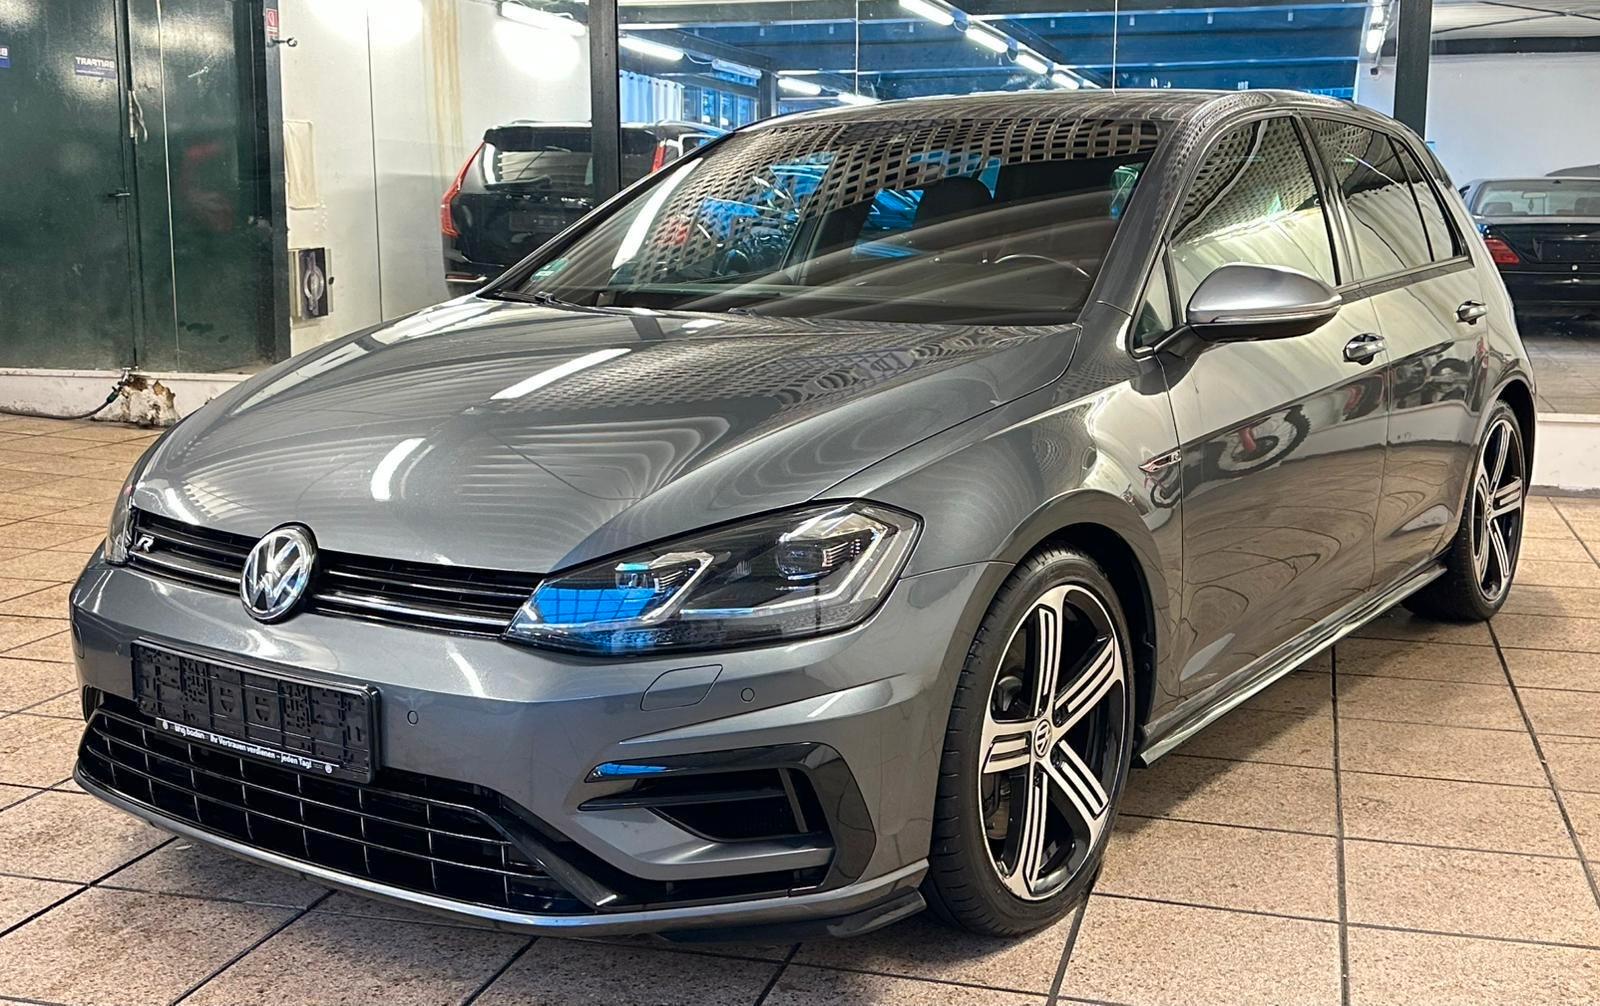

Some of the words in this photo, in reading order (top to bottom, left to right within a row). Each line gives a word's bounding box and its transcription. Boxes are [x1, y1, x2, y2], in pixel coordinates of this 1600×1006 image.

[136, 533, 155, 552] R
[218, 735, 247, 752] Vertrauen
[246, 745, 276, 759] verdienen
[280, 752, 298, 765] jeden
